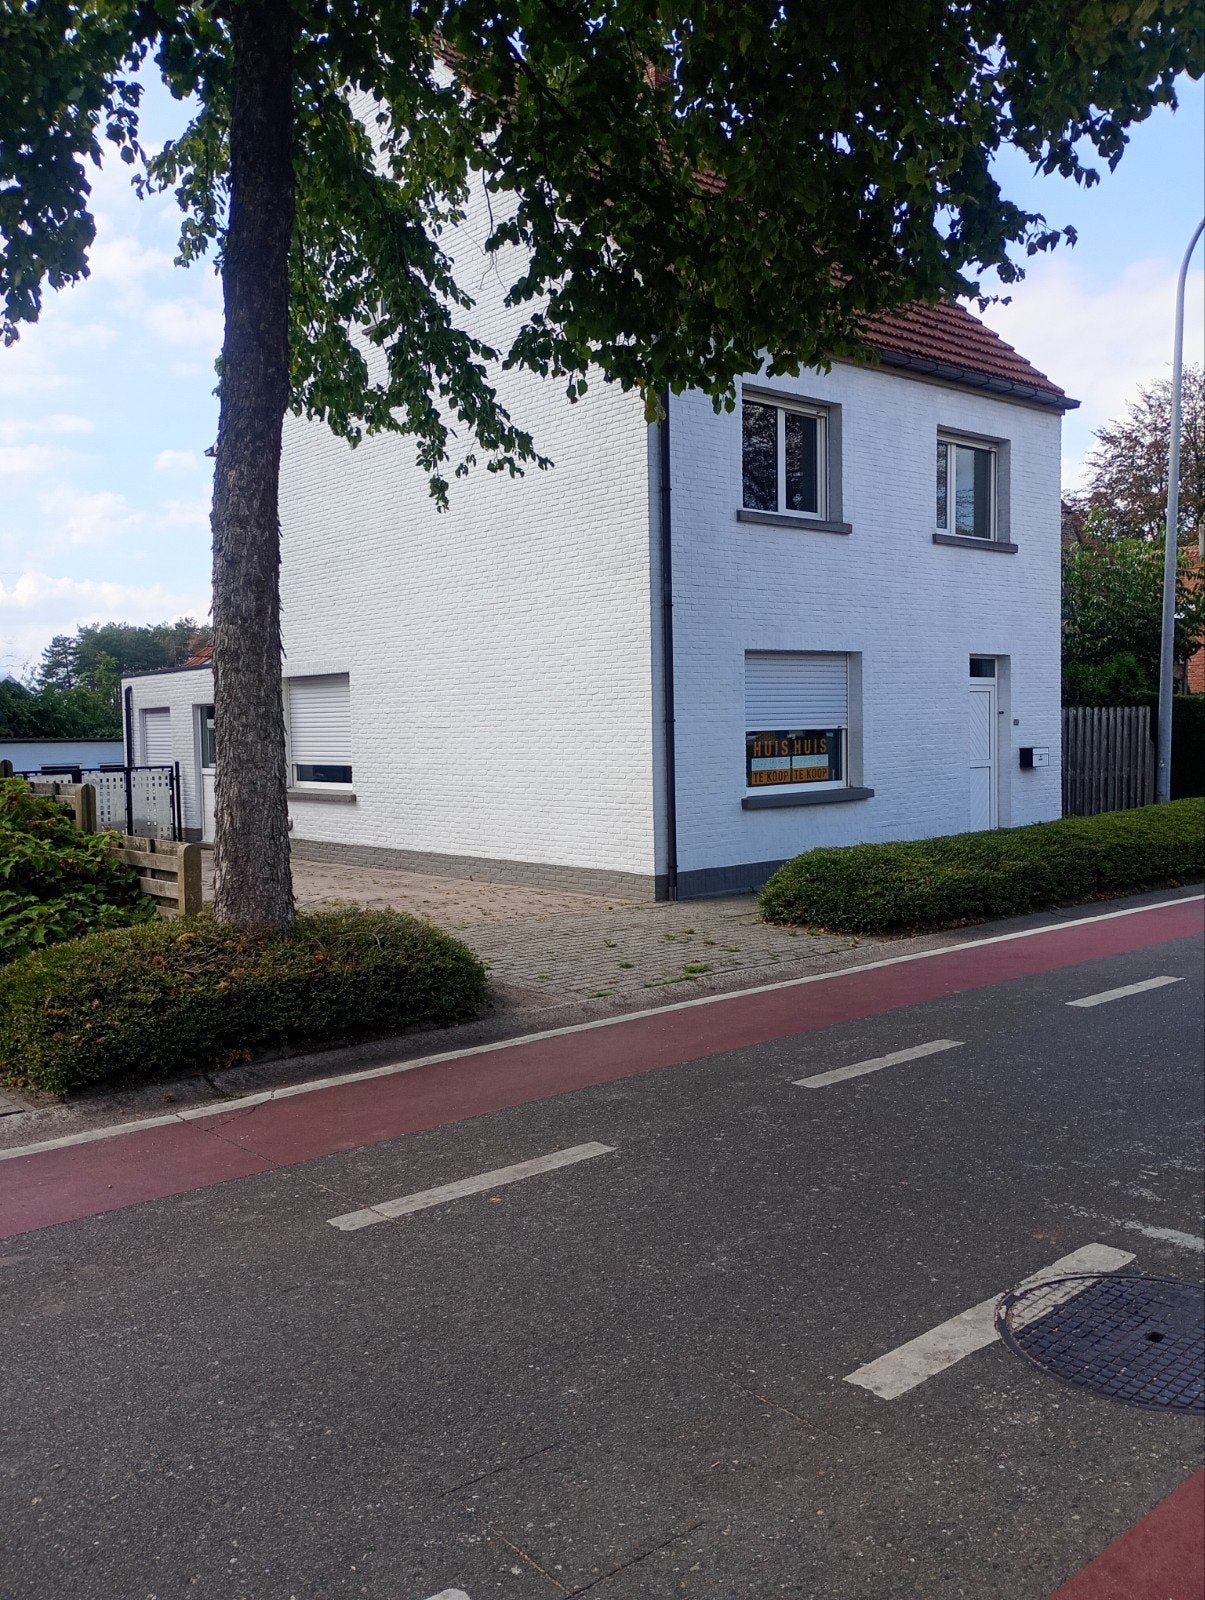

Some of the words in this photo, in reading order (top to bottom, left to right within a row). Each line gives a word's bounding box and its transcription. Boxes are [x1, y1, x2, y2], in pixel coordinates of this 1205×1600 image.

[753, 740, 789, 756] HUIS
[794, 738, 827, 754] HUIS
[753, 772, 764, 783] TE
[766, 770, 789, 782] KOOP
[794, 769, 804, 781] TE
[806, 767, 827, 779] KOOP
